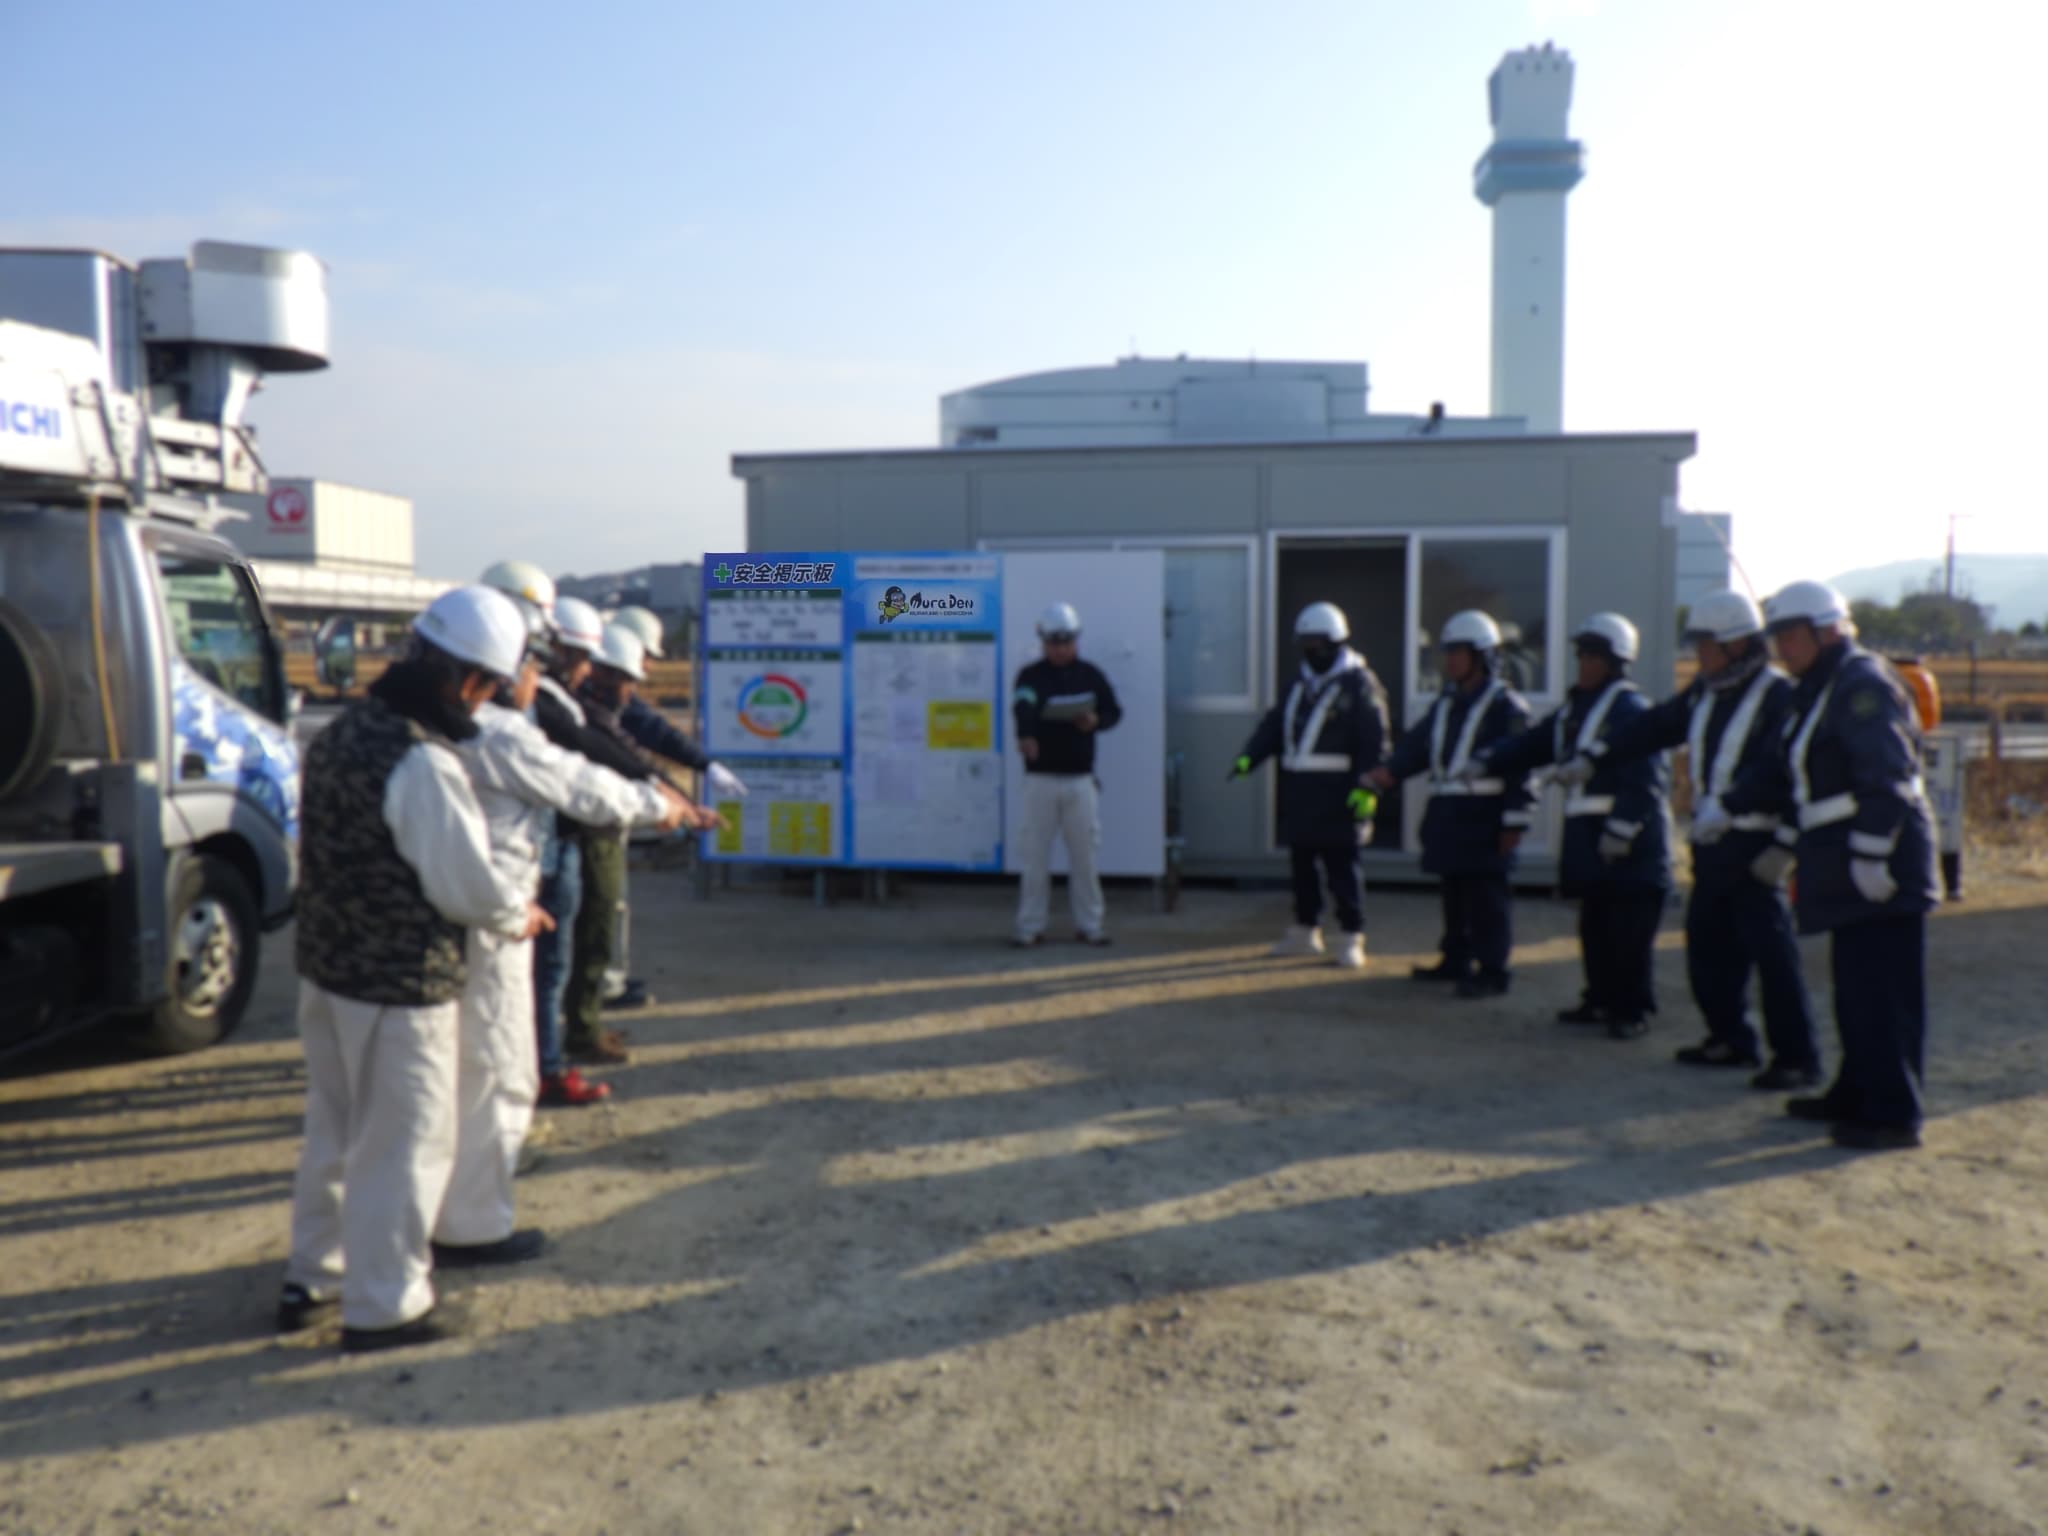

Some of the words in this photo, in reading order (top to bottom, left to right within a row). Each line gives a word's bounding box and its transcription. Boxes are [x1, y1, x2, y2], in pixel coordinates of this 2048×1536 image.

[733, 562, 835, 583] 安全掲示板
